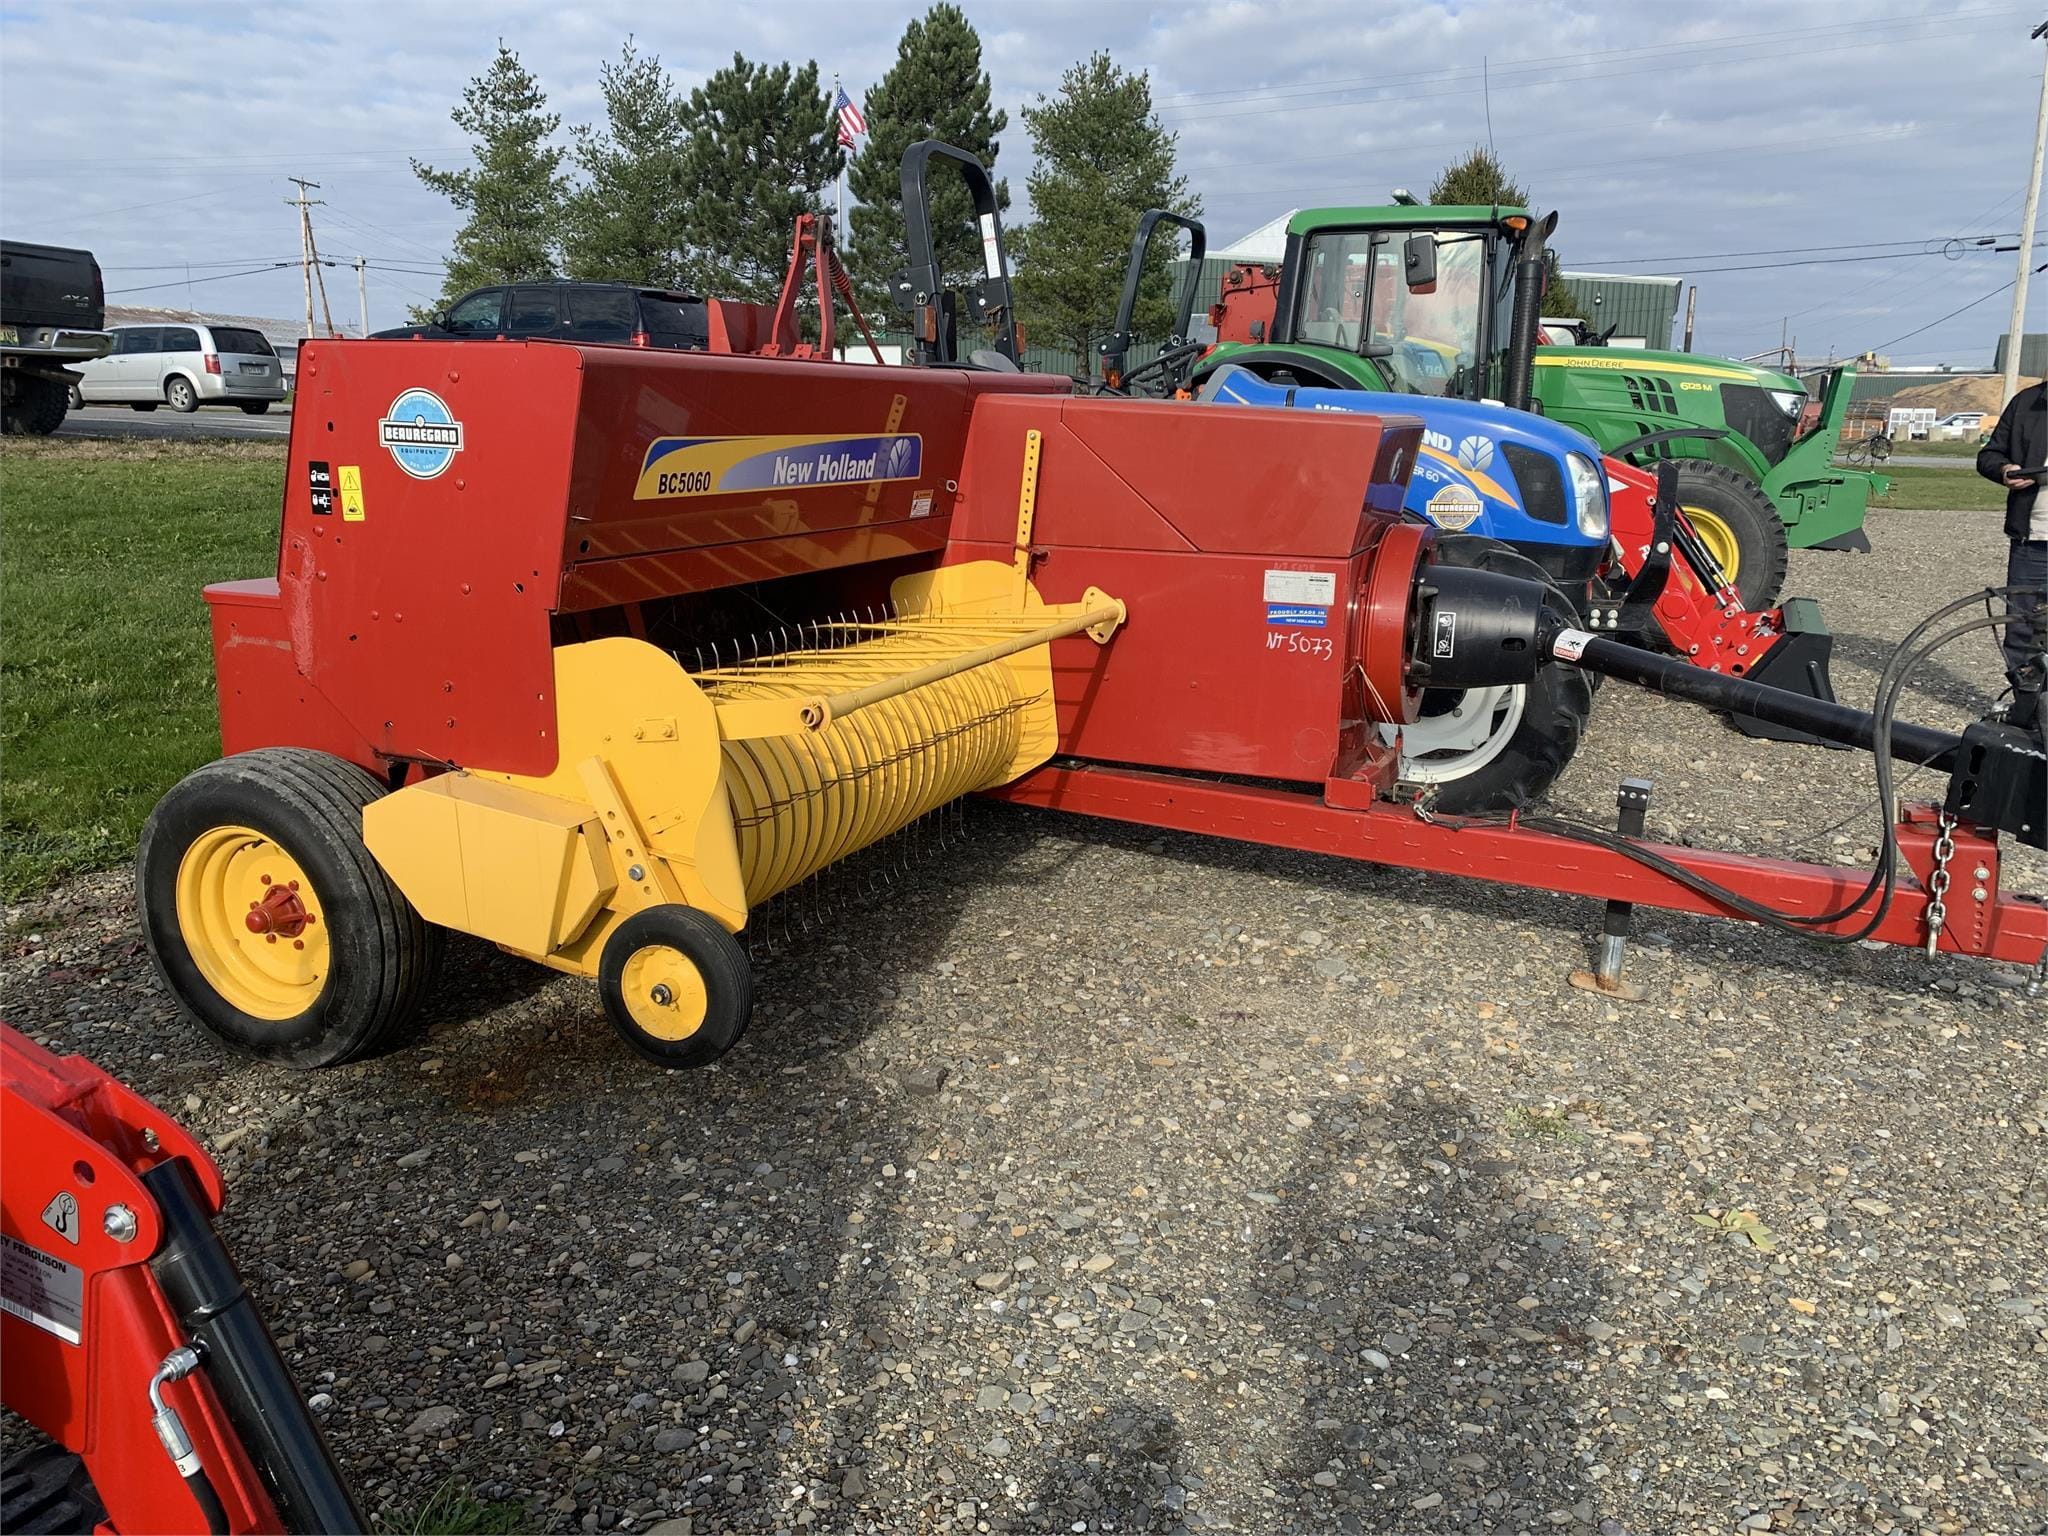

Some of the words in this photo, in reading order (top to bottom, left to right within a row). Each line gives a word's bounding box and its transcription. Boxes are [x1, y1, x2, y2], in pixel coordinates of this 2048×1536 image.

[1565, 358, 1591, 367] JOHN
[1592, 359, 1624, 369] DEERE
[385, 426, 457, 443] BEAUREGARD
[1421, 430, 1453, 453] ND
[772, 456, 814, 485] New
[816, 452, 878, 482] Holland
[1425, 470, 1440, 483] 60
[658, 470, 711, 495] BC5060
[1266, 631, 1288, 650] NT
[1288, 631, 1333, 661] 5073
[13, 1242, 67, 1274] FERGUSON
